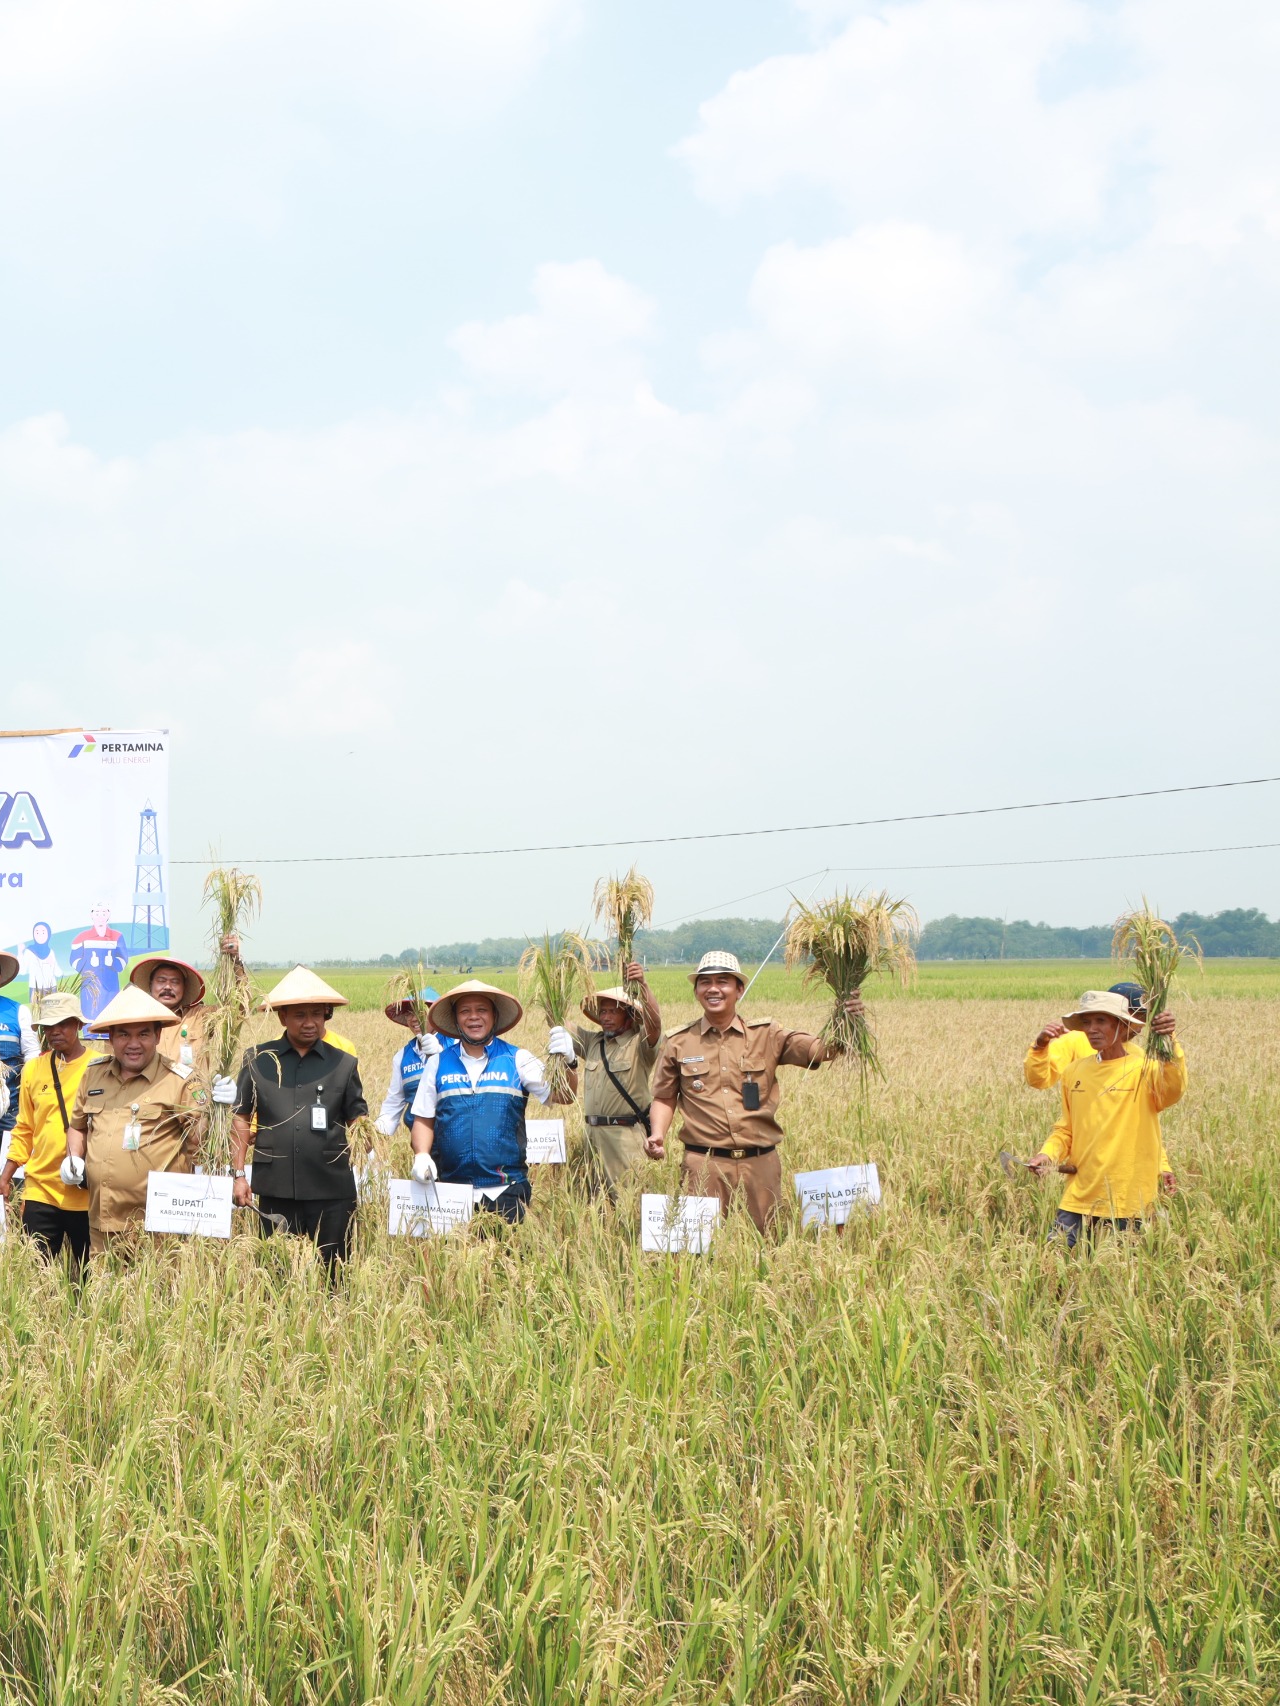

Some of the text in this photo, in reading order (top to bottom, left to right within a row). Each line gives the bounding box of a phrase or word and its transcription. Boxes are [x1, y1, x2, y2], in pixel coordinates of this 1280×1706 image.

[102, 743, 164, 752] PERTAMINA
[403, 1062, 425, 1074] PERTA
[441, 1071, 509, 1085] PERTAMINA
[810, 1191, 843, 1201] KEPALA
[172, 1198, 204, 1208] BUPATI
[396, 1203, 464, 1214] GENERAL MANAGER
